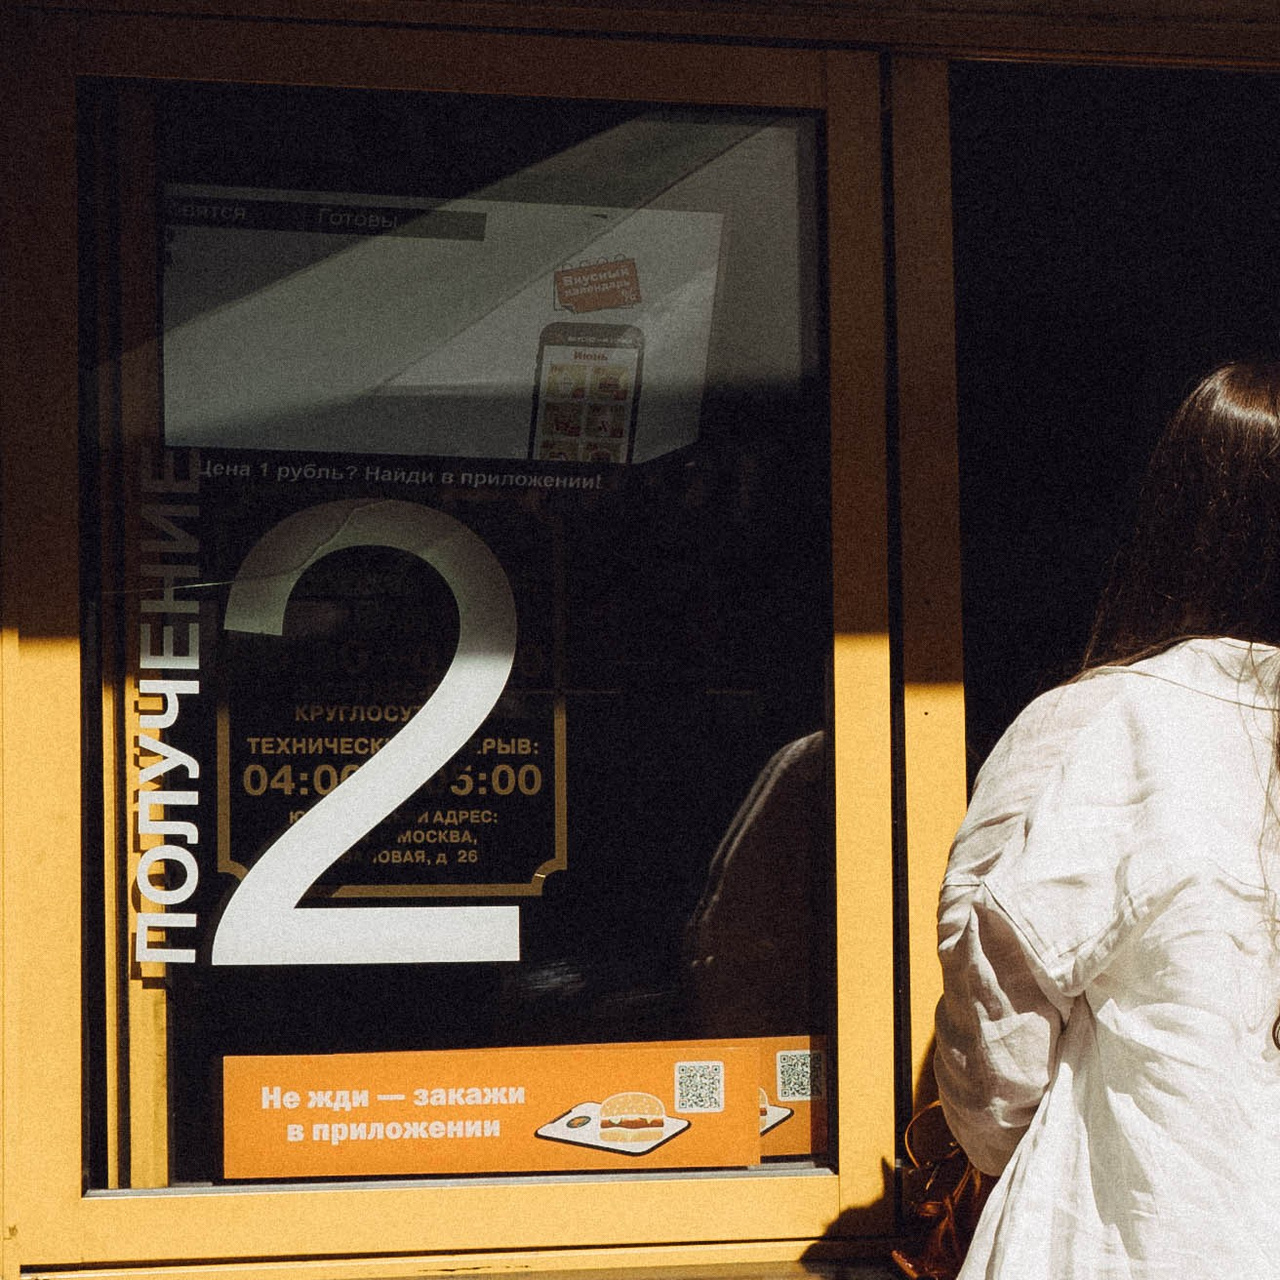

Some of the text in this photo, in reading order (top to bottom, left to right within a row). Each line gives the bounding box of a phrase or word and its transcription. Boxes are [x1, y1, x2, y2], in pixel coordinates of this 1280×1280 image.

[182, 205, 398, 228] вятся Готовы
[562, 268, 629, 287] Вкусный
[260, 463, 268, 476] 1
[277, 464, 358, 482] рубль?
[365, 467, 434, 484] Найди
[442, 473, 453, 484] в
[461, 472, 602, 489] приложении!
[135, 443, 199, 966] ПОЛУЧЕНИЕ
[295, 705, 420, 722] КРУГЛОСУ
[211, 497, 521, 965] 2
[247, 737, 384, 754] ТЕХНИЧЕСК
[434, 810, 498, 825] АДРЕС:
[458, 850, 478, 863] 26
[261, 1086, 302, 1110] Не
[308, 1087, 369, 1111] жди
[413, 1086, 526, 1107] закажи
[287, 1116, 501, 1145] в приложении
